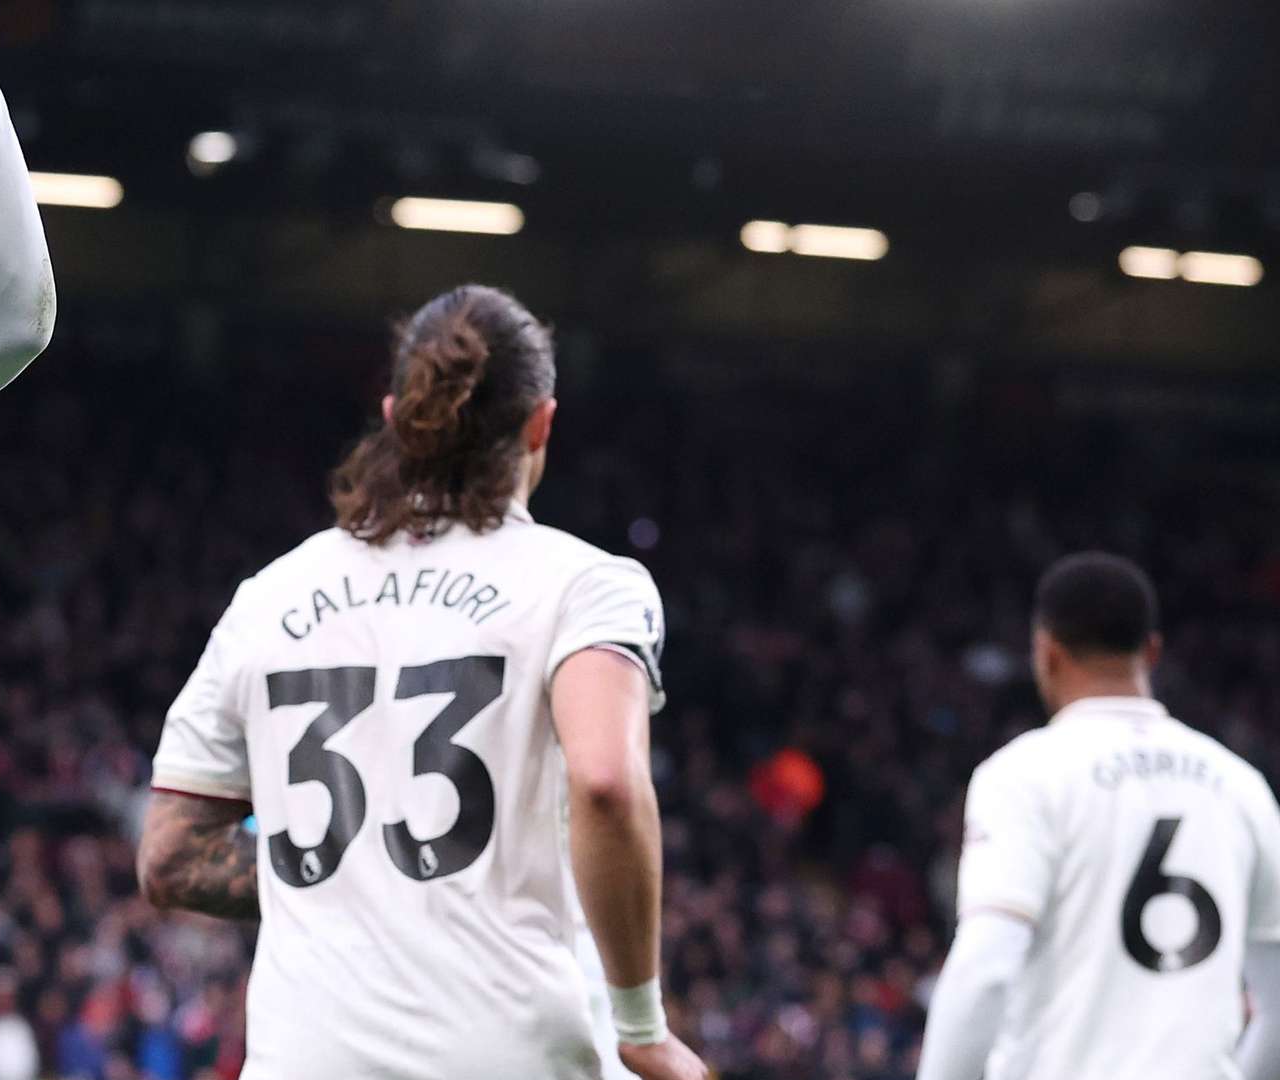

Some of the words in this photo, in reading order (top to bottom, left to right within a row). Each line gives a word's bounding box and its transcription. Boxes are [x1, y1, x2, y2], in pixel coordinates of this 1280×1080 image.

[281, 569, 511, 640] CALAFIORI
[266, 655, 505, 888] 33
[1121, 817, 1221, 972] 6
